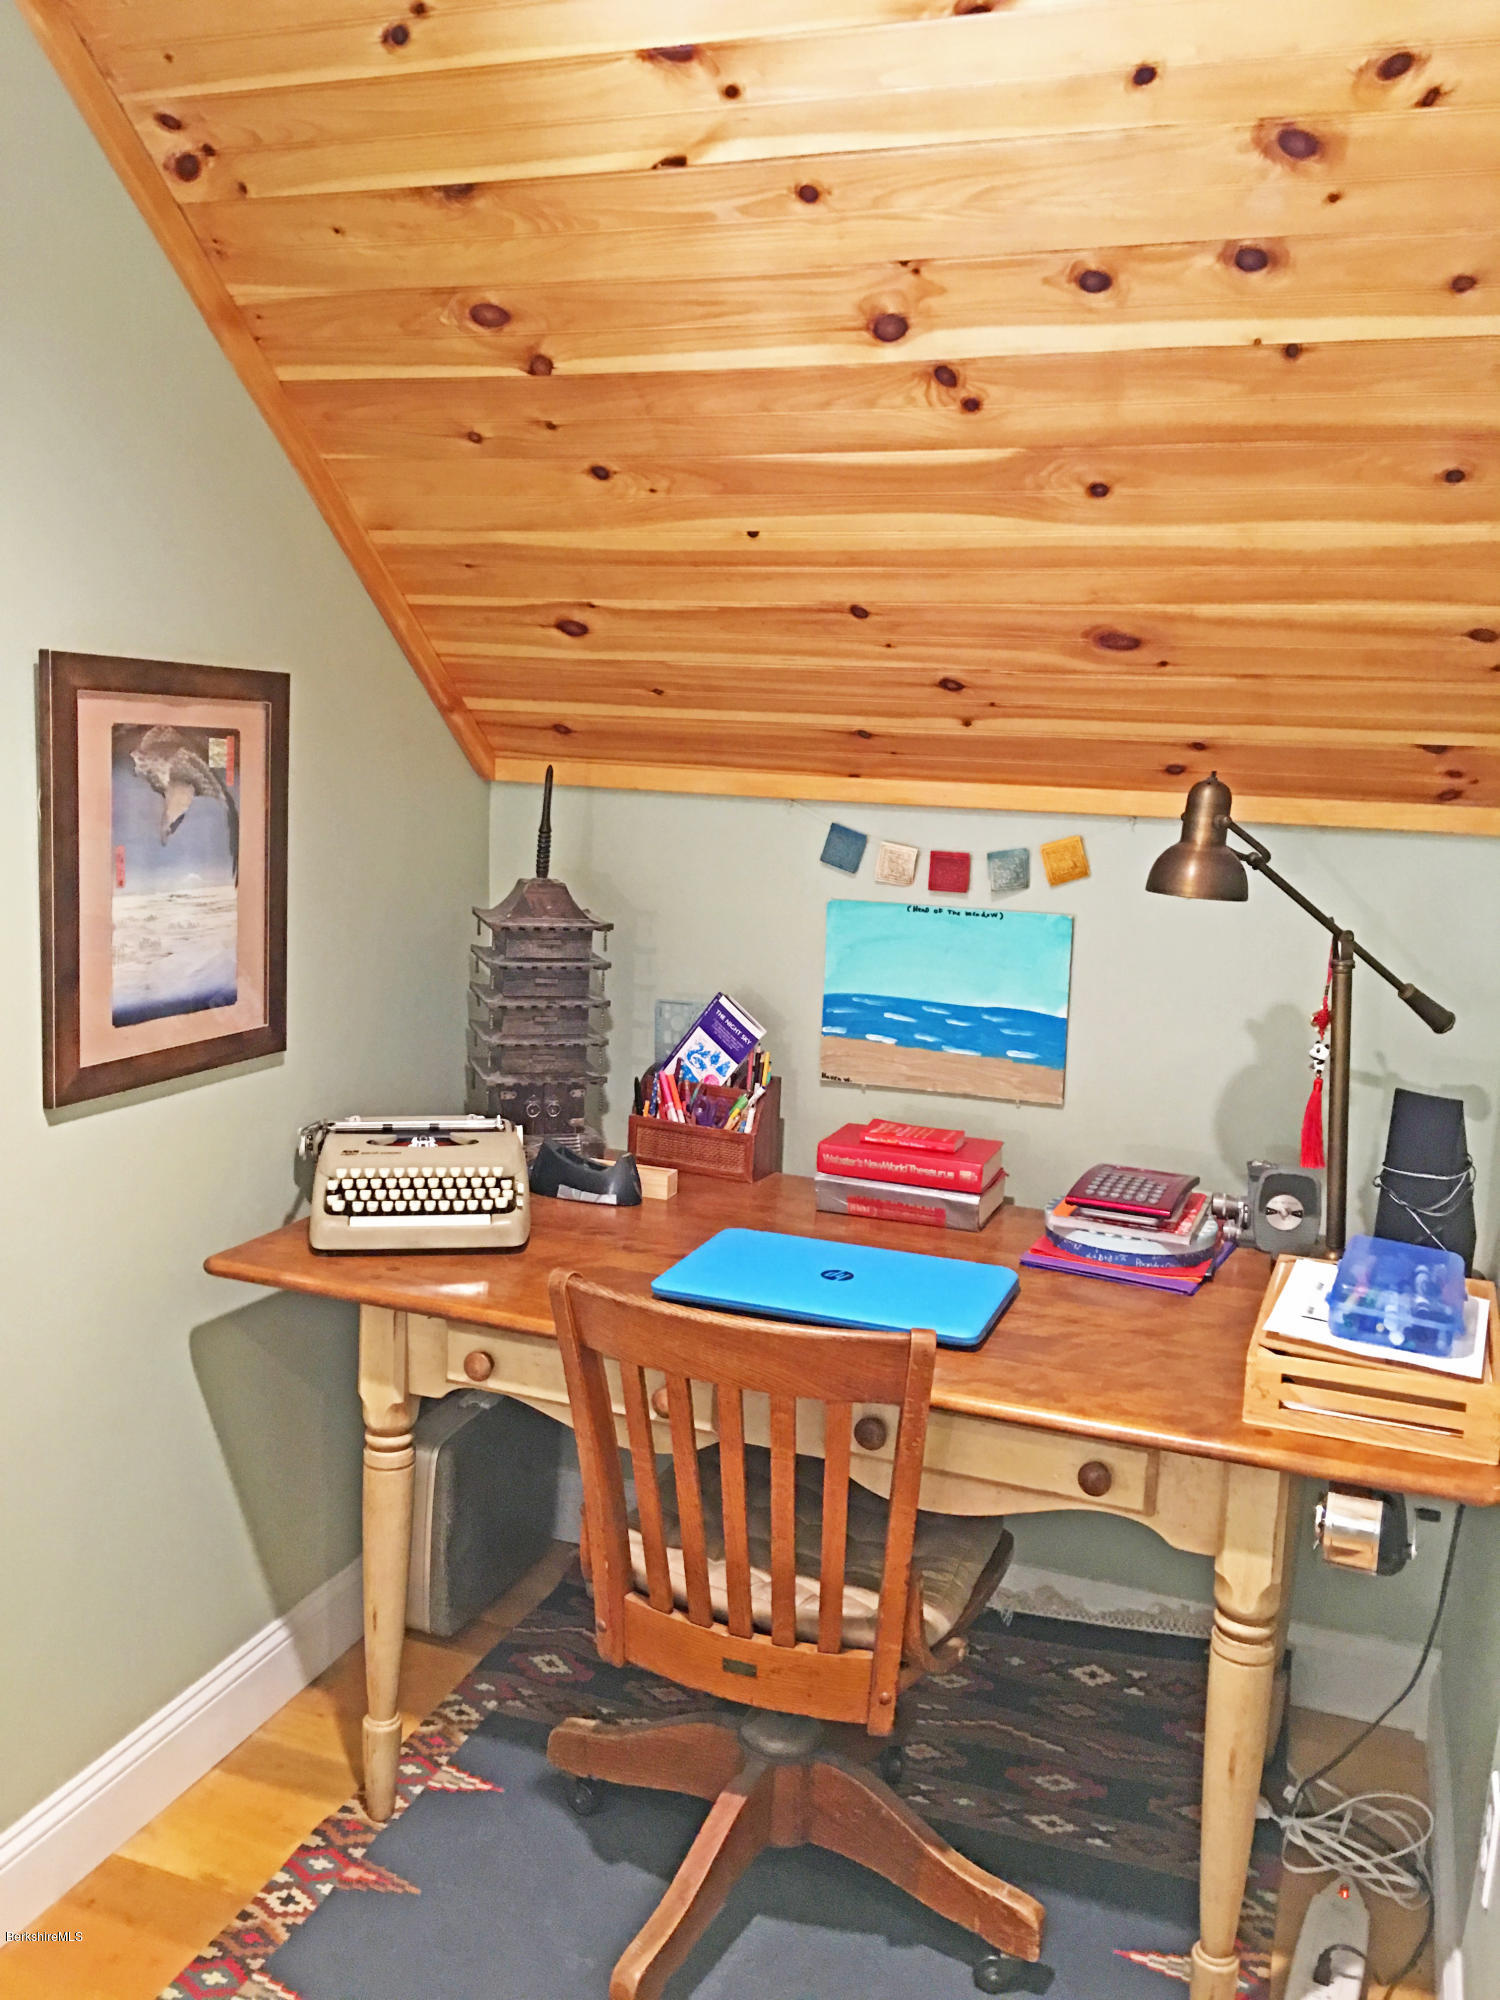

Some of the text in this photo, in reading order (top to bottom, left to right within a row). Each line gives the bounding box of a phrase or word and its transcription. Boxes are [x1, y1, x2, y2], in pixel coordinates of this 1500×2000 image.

[716, 1009, 726, 1021] THE
[725, 1019, 742, 1036] NIGHT
[740, 1034, 752, 1045] SKY
[822, 1153, 864, 1168] Webster's
[864, 1158, 881, 1169] New
[881, 1161, 908, 1174] World
[908, 1163, 955, 1179] Thesaurus
